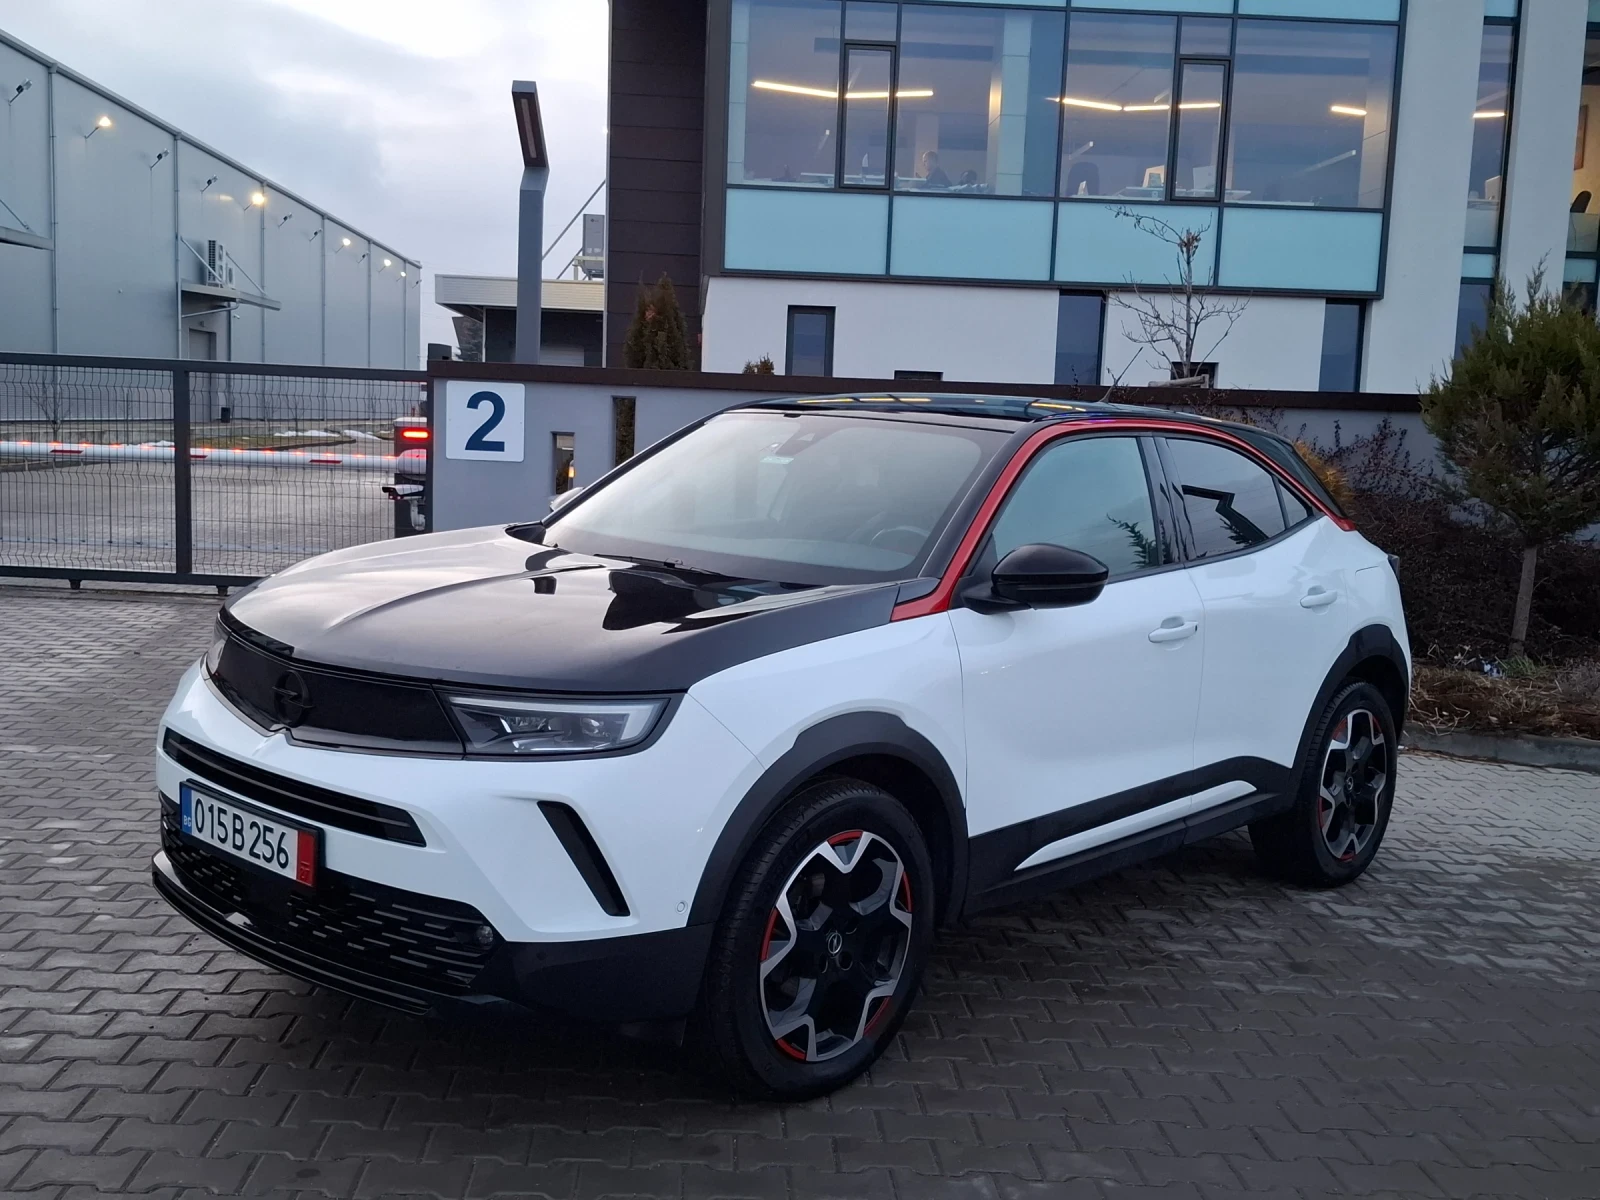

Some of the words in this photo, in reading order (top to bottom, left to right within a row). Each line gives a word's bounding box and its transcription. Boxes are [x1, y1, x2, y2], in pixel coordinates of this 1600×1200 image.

[465, 391, 505, 452] 2
[183, 815, 192, 827] BG
[195, 798, 289, 869] 015B256
